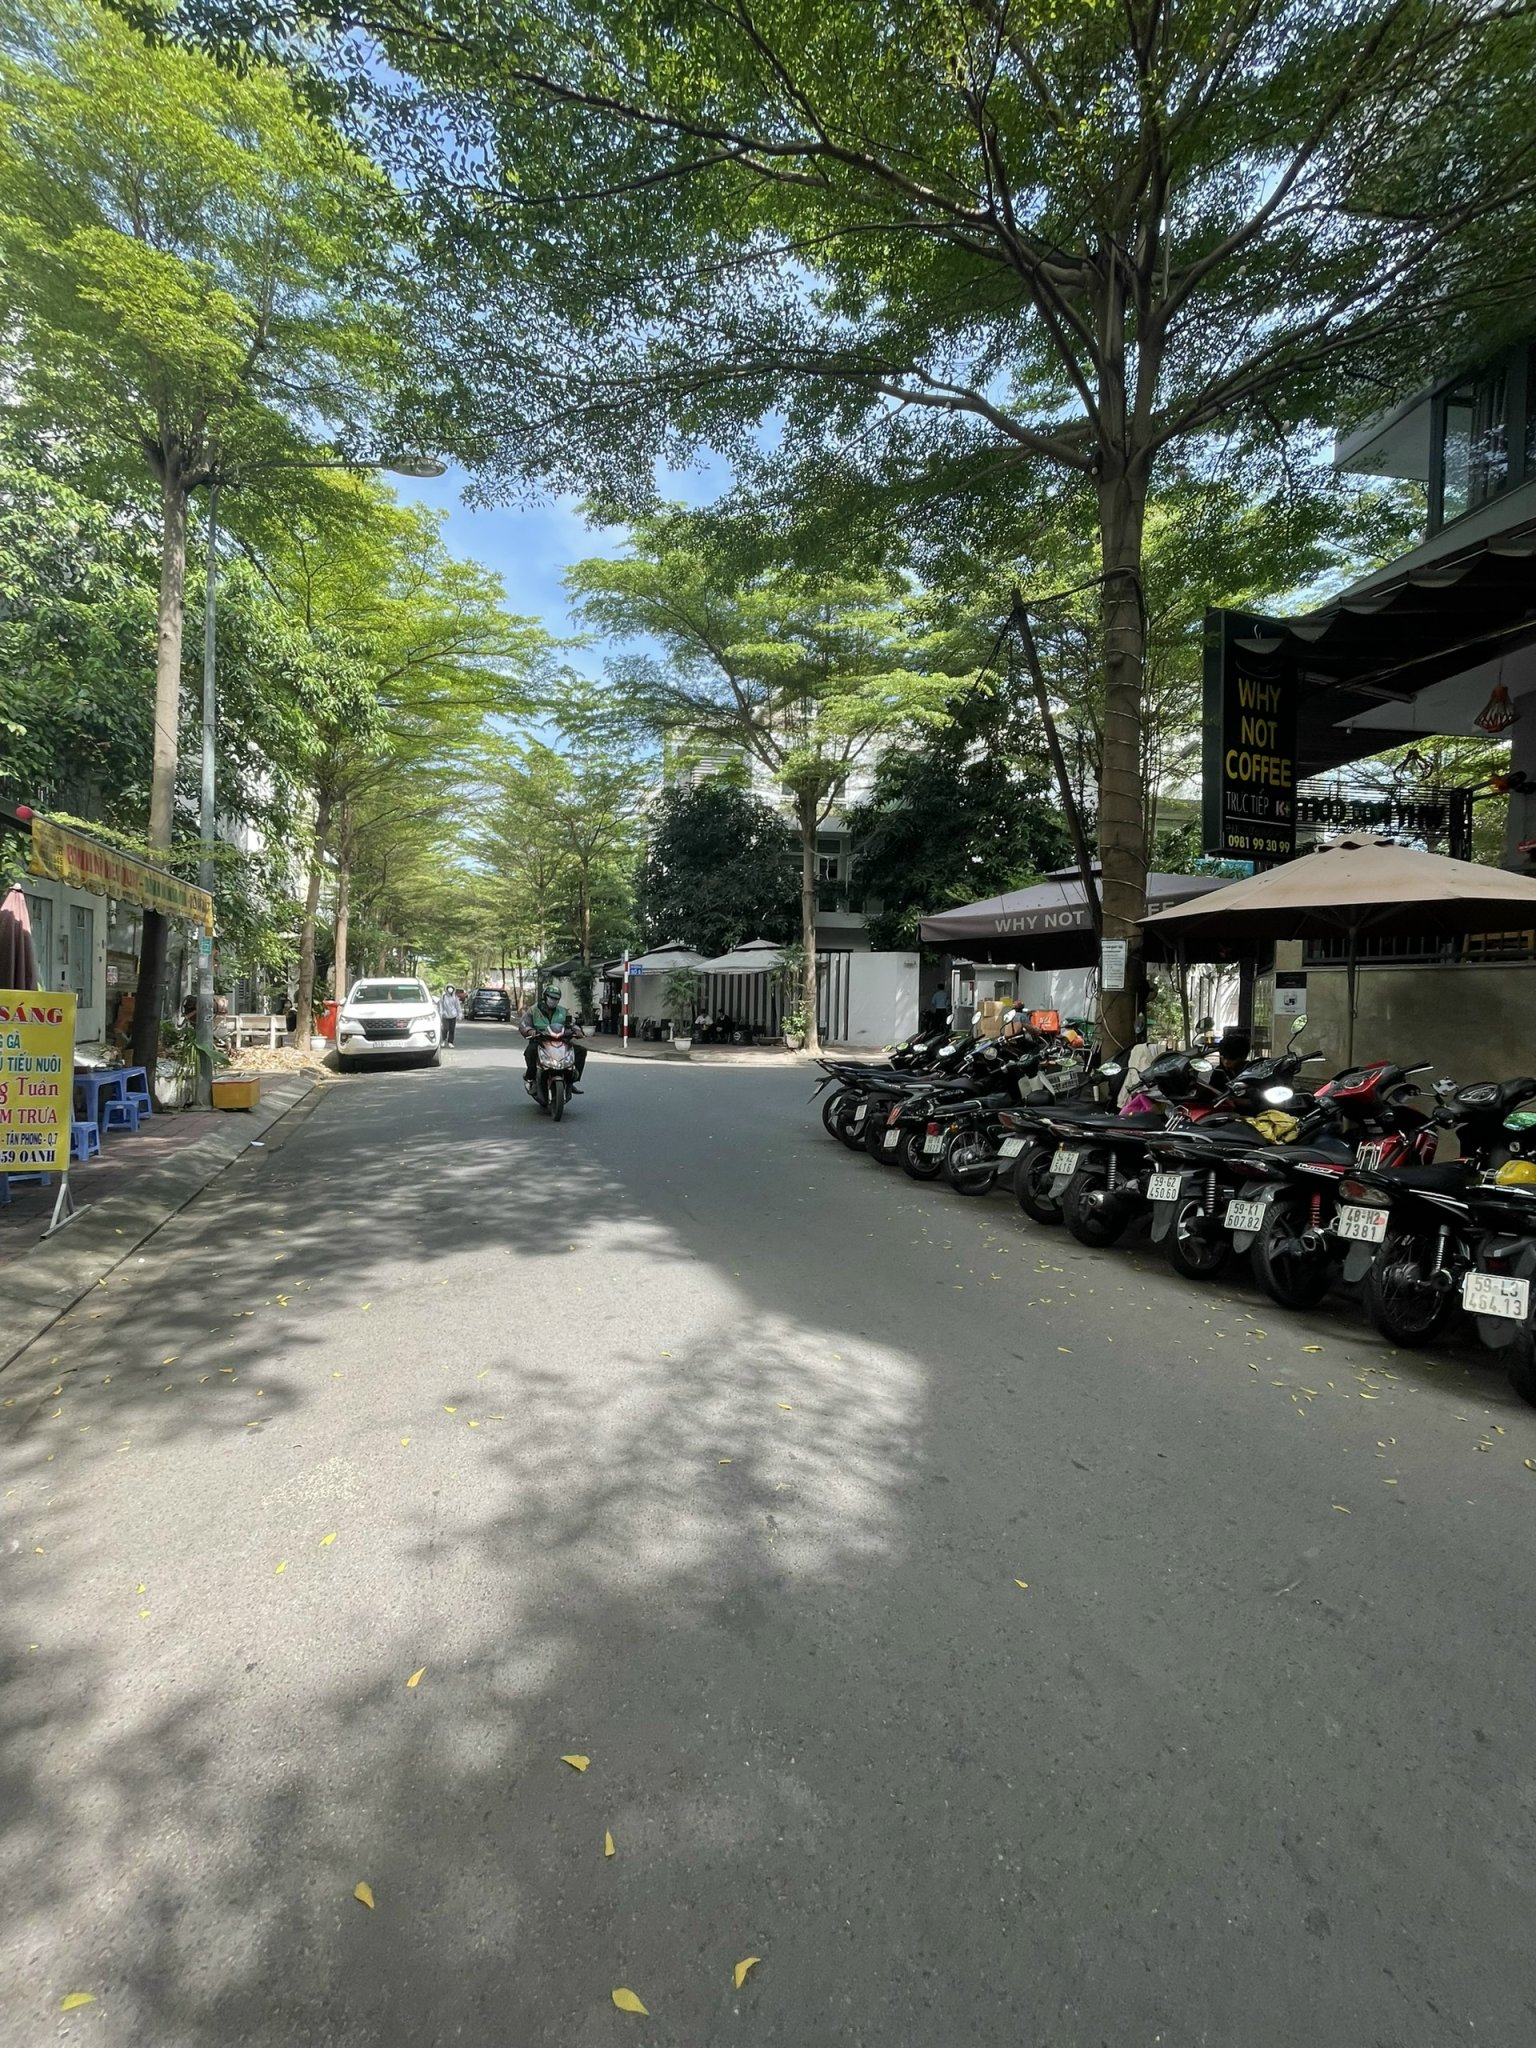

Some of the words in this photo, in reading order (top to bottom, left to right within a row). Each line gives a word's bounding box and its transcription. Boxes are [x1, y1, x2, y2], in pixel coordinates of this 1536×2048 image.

[1239, 678, 1281, 714] WHY
[1242, 715, 1278, 750] NOT
[1225, 749, 1292, 788] COFFEE
[1275, 800, 1291, 817] K+
[1228, 834, 1250, 849] 0981
[1253, 837, 1264, 850] 99
[1266, 839, 1277, 852] 30
[1279, 841, 1290, 853] 99
[995, 916, 1038, 933] WHY
[1044, 910, 1085, 927] NOT
[0, 1002, 63, 1024] SÁNG
[7, 1030, 20, 1049] GÀ
[36, 1055, 61, 1072] NUÔI
[17, 1106, 57, 1124] TRƯA
[6, 1130, 19, 1145] TÂN
[20, 1132, 42, 1145] PHONG
[20, 1150, 55, 1163] OANH
[1344, 1222, 1377, 1240] 7381
[1474, 1276, 1519, 1298] 59-L3
[1469, 1292, 1522, 1316] 464.13
